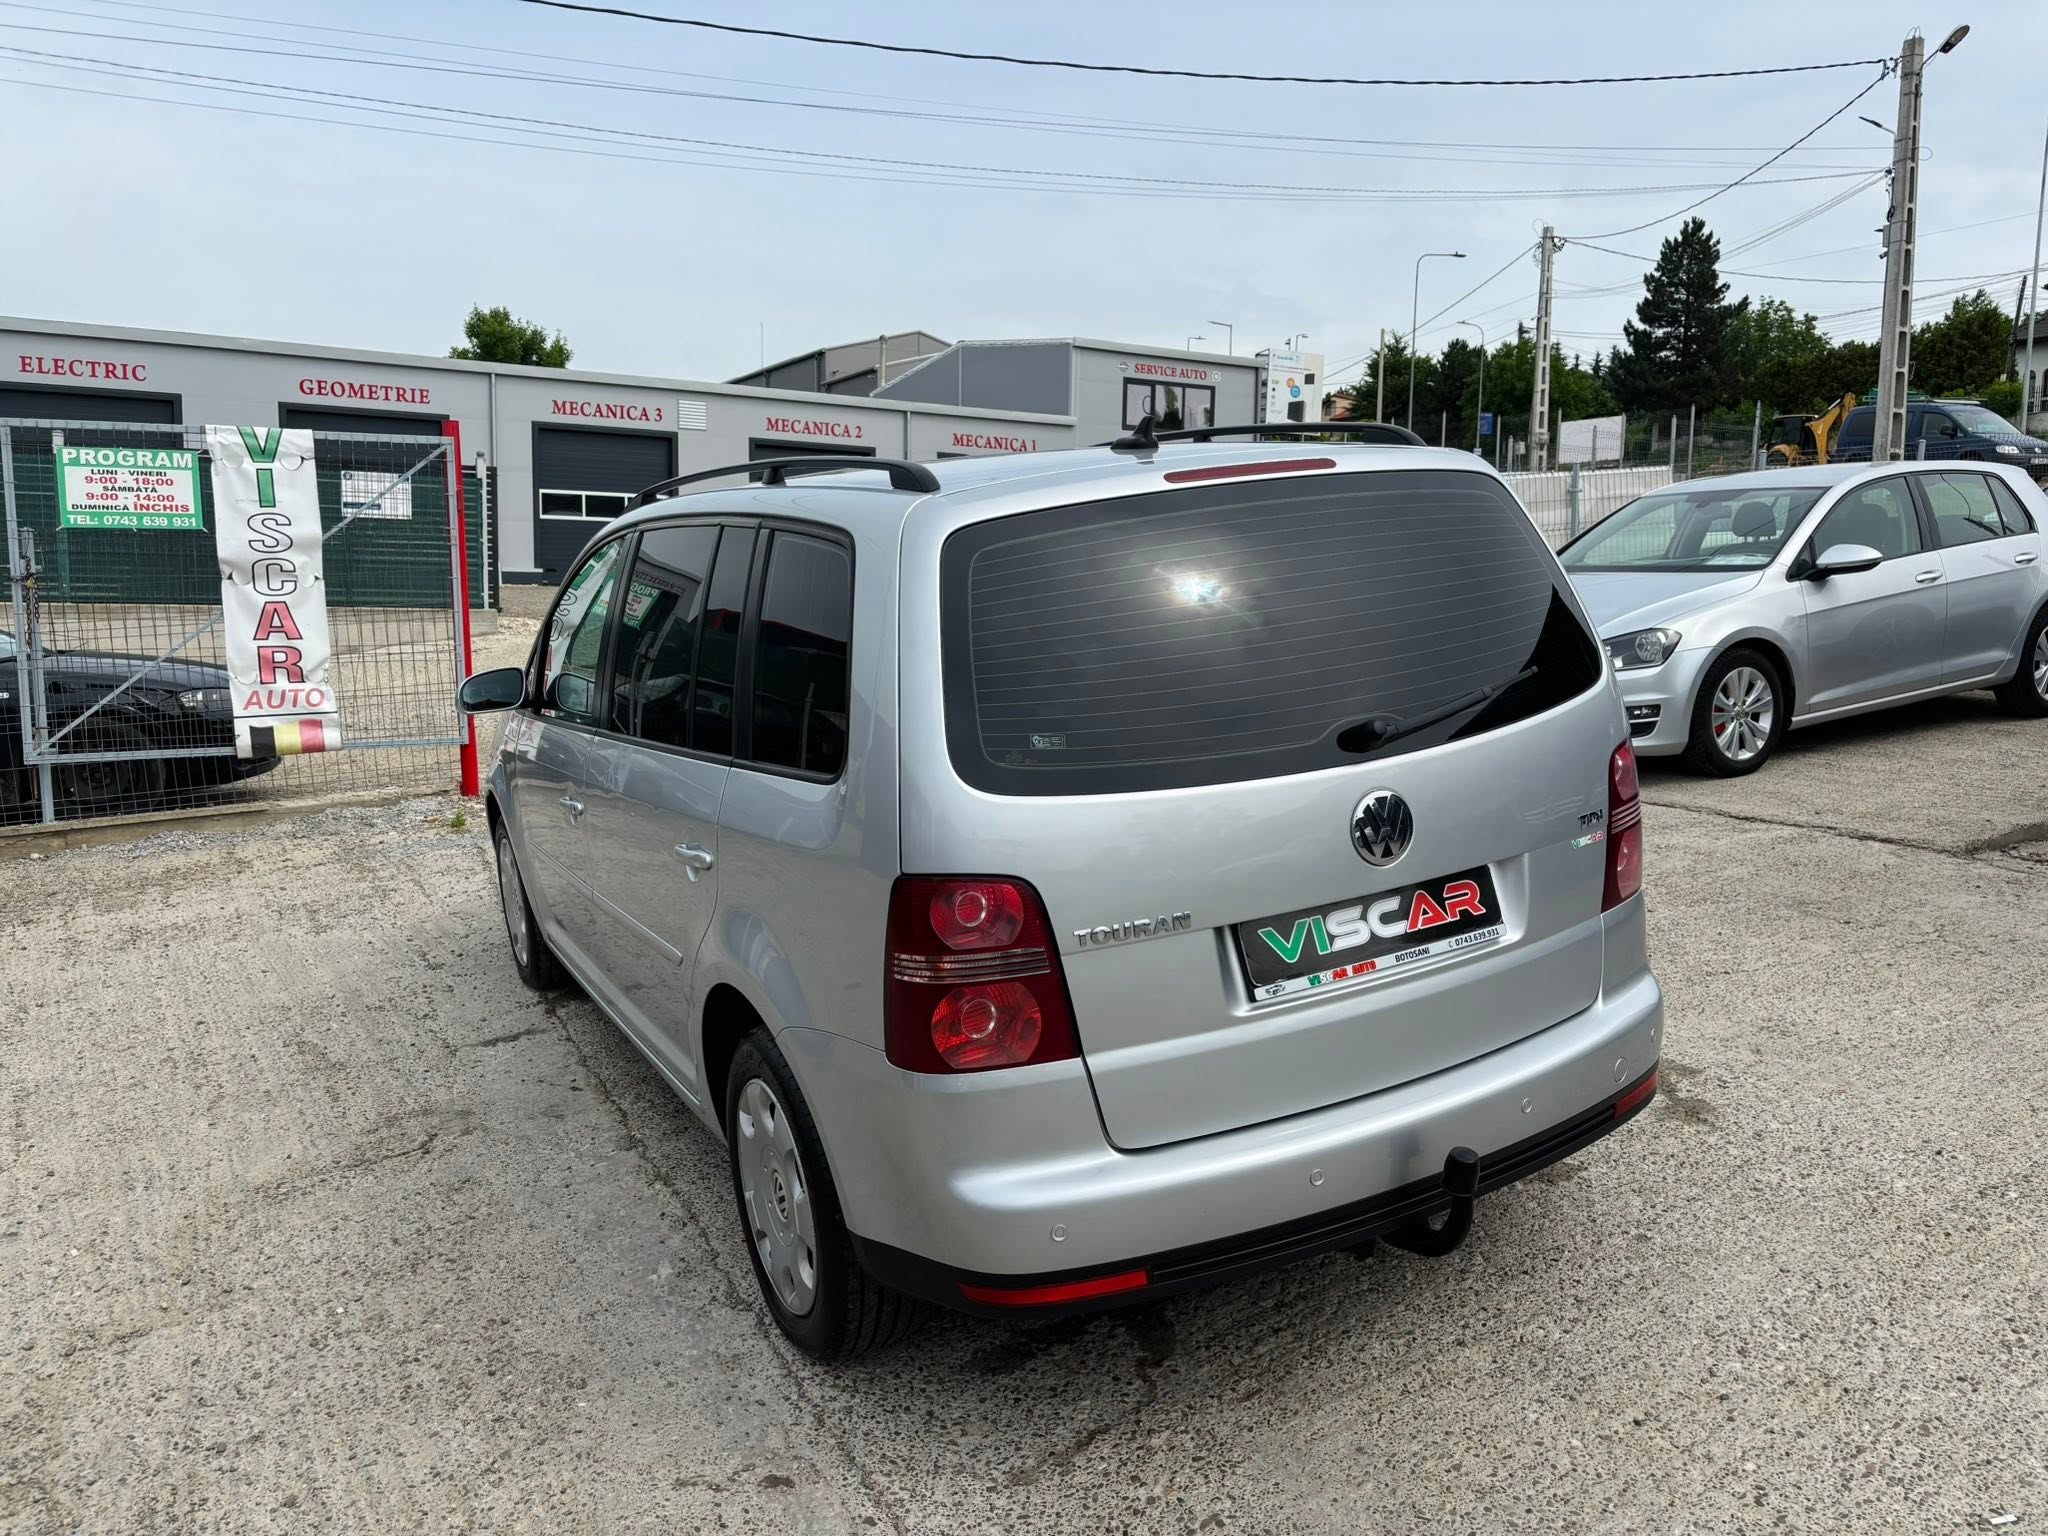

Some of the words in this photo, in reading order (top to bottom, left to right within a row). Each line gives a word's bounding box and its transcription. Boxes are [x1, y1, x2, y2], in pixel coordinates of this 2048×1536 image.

[19, 355, 147, 382] ELECTRIC
[1134, 363, 1177, 377] SERVICE
[1179, 368, 1207, 380] AUTO
[299, 378, 430, 404] GEOMETRIE
[551, 399, 650, 421] MECANICA
[652, 408, 663, 422] 3
[766, 417, 849, 438] MECANICA
[851, 425, 863, 438] 2
[952, 433, 1027, 452] MECANICA
[1031, 440, 1037, 451] 1
[62, 448, 193, 468] PROGRAM
[85, 476, 118, 484] 9:00
[133, 478, 174, 486] 18:00
[86, 492, 119, 500] 9:00
[134, 494, 175, 502] 14:00
[67, 515, 98, 525] TEL:
[104, 516, 138, 525] 0743
[143, 517, 168, 526] 639
[173, 518, 196, 527] 931
[237, 425, 305, 684] VISCAR
[243, 688, 325, 711] AUTO
[1073, 911, 1192, 948] TOURAN
[1258, 879, 1486, 964] VISCAR
[1395, 947, 1431, 963] BOTOSANI
[1455, 927, 1500, 946] 0743.639.931
[1307, 967, 1349, 987] VISCAR
[1352, 960, 1377, 975] AUTO
